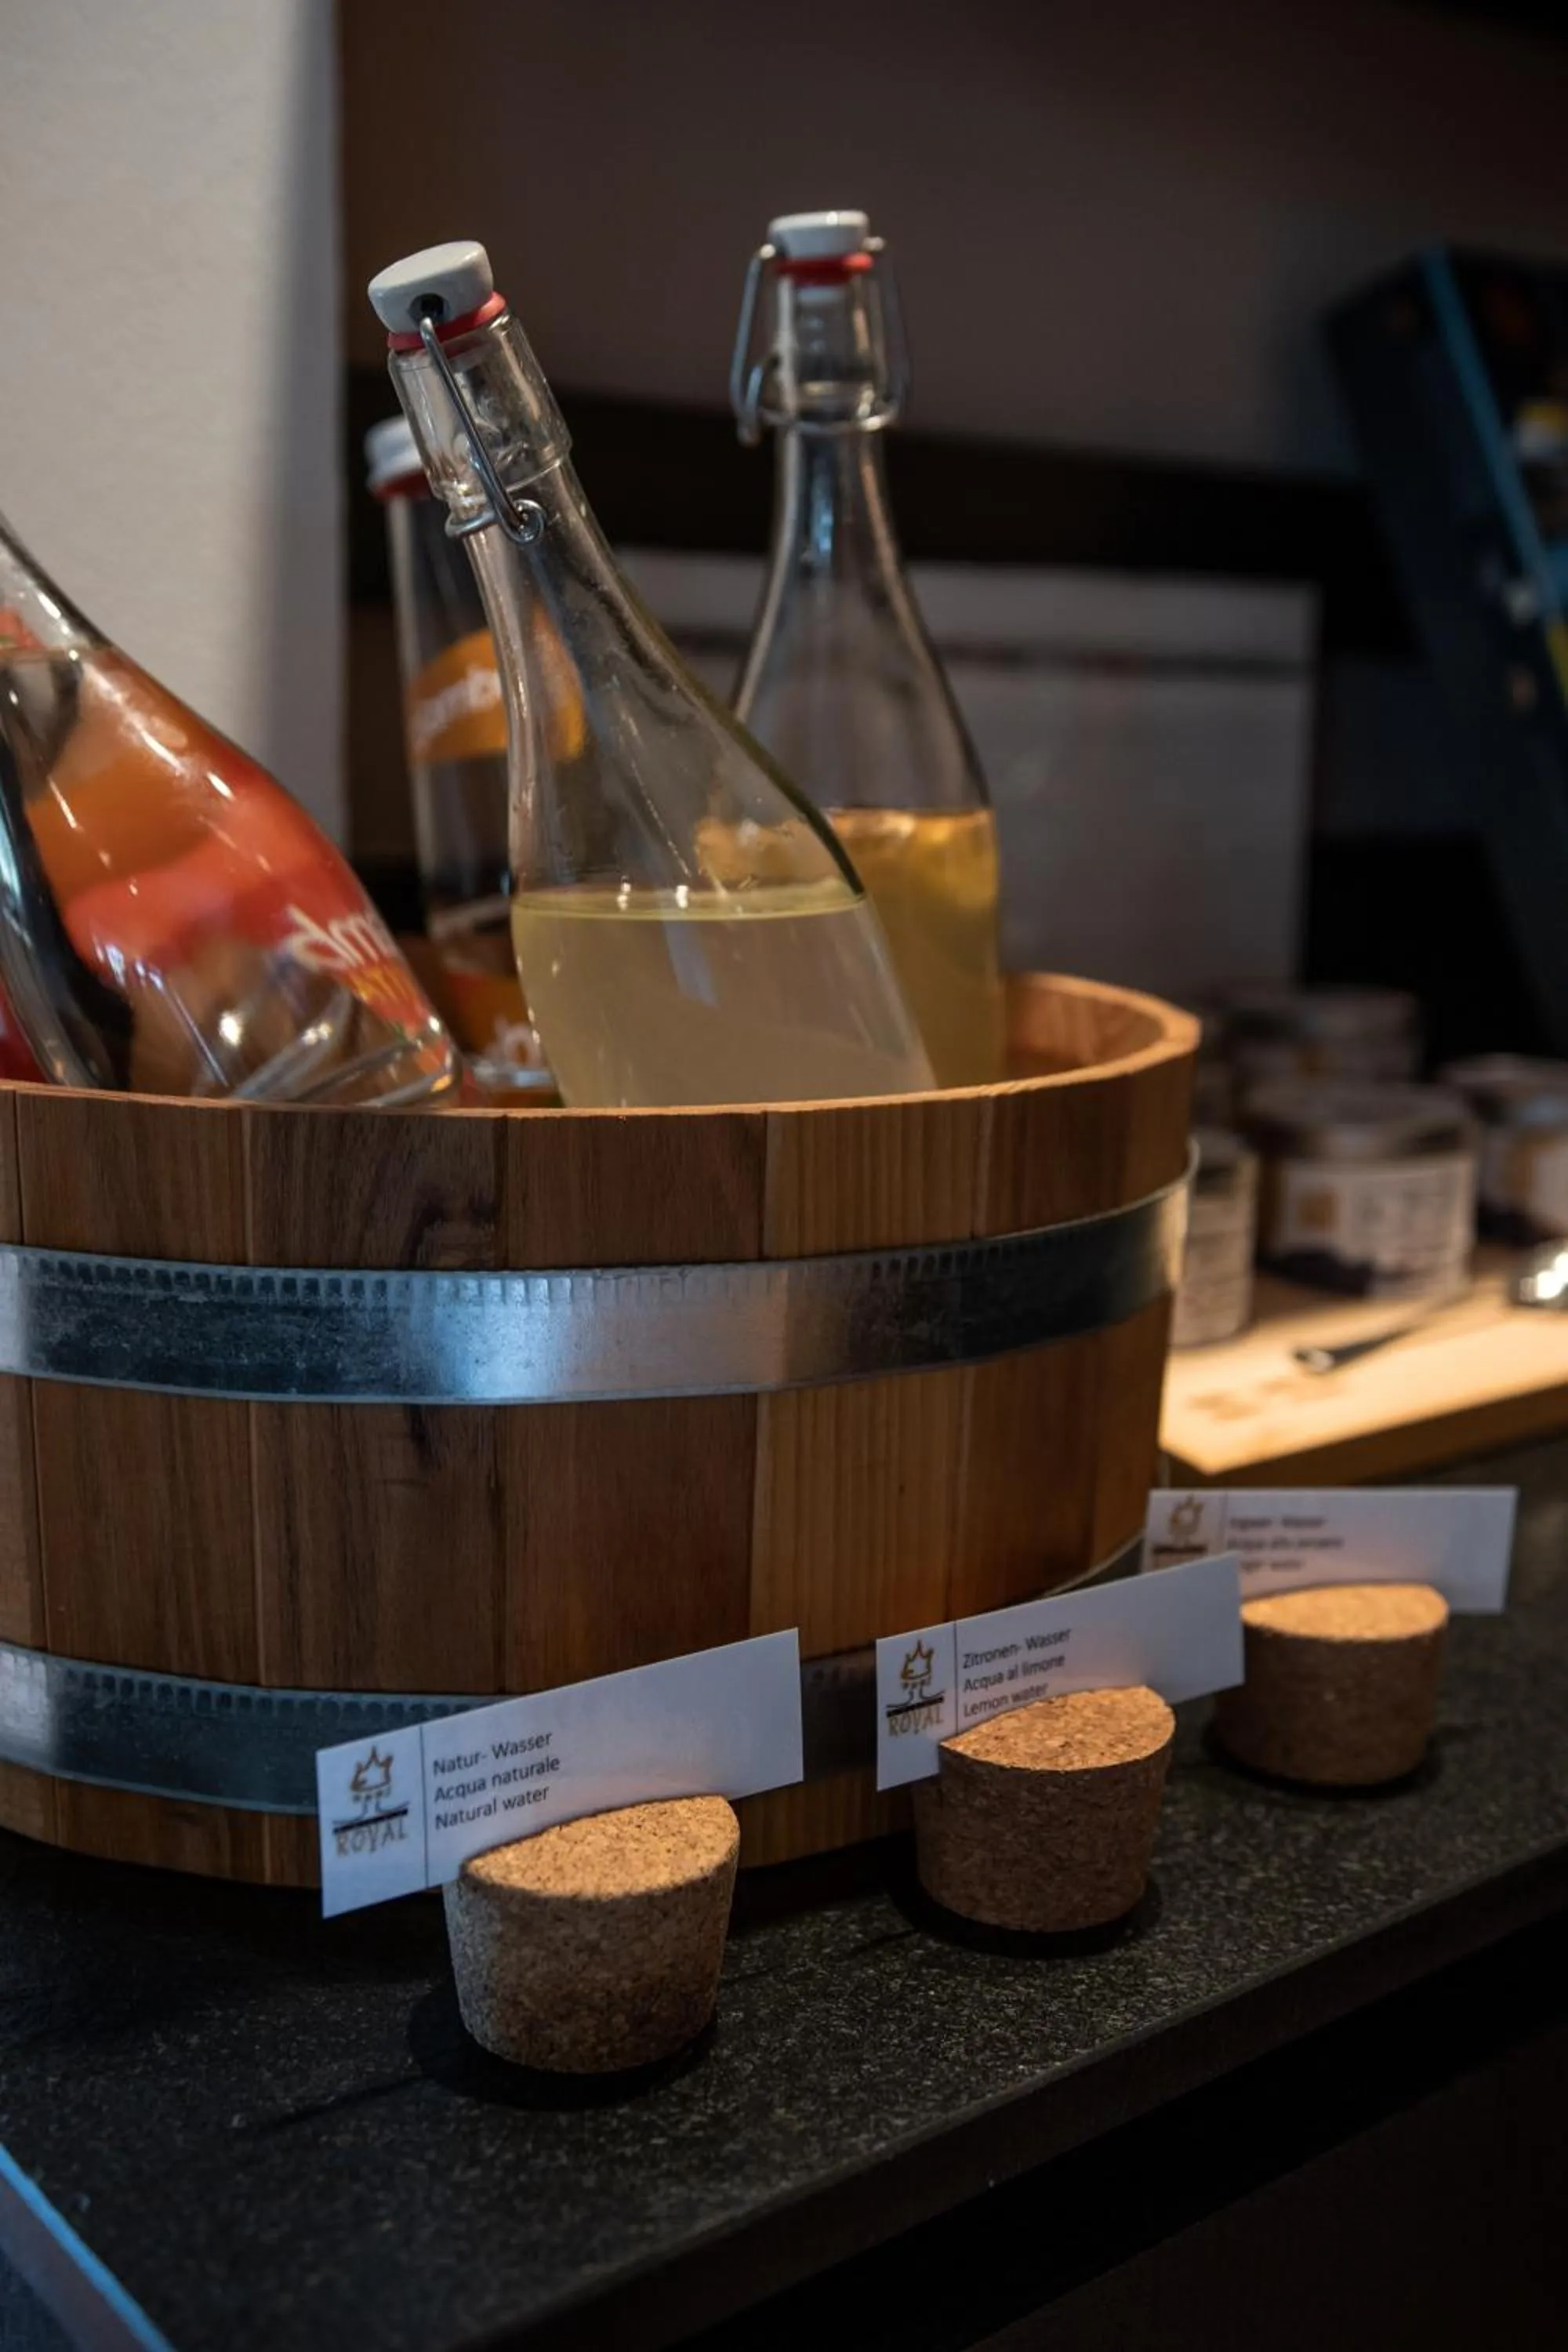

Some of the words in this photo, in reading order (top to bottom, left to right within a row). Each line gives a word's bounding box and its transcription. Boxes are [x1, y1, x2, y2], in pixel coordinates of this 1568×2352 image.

[1025, 1628, 1072, 1650] Wasser
[964, 1671, 1004, 1693] Acqua
[1007, 1664, 1018, 1681] al
[1022, 1654, 1065, 1677] limone
[964, 1694, 1009, 1717] Lemon
[1011, 1682, 1048, 1703] water
[888, 1705, 945, 1737] ROYAL
[433, 1751, 488, 1777] Natur-
[491, 1732, 552, 1760] Wasser
[434, 1777, 486, 1802] Acqua
[492, 1756, 561, 1788] naturale
[435, 1797, 497, 1830] Natural
[502, 1786, 550, 1811] water
[336, 1817, 408, 1858] ROYAL
